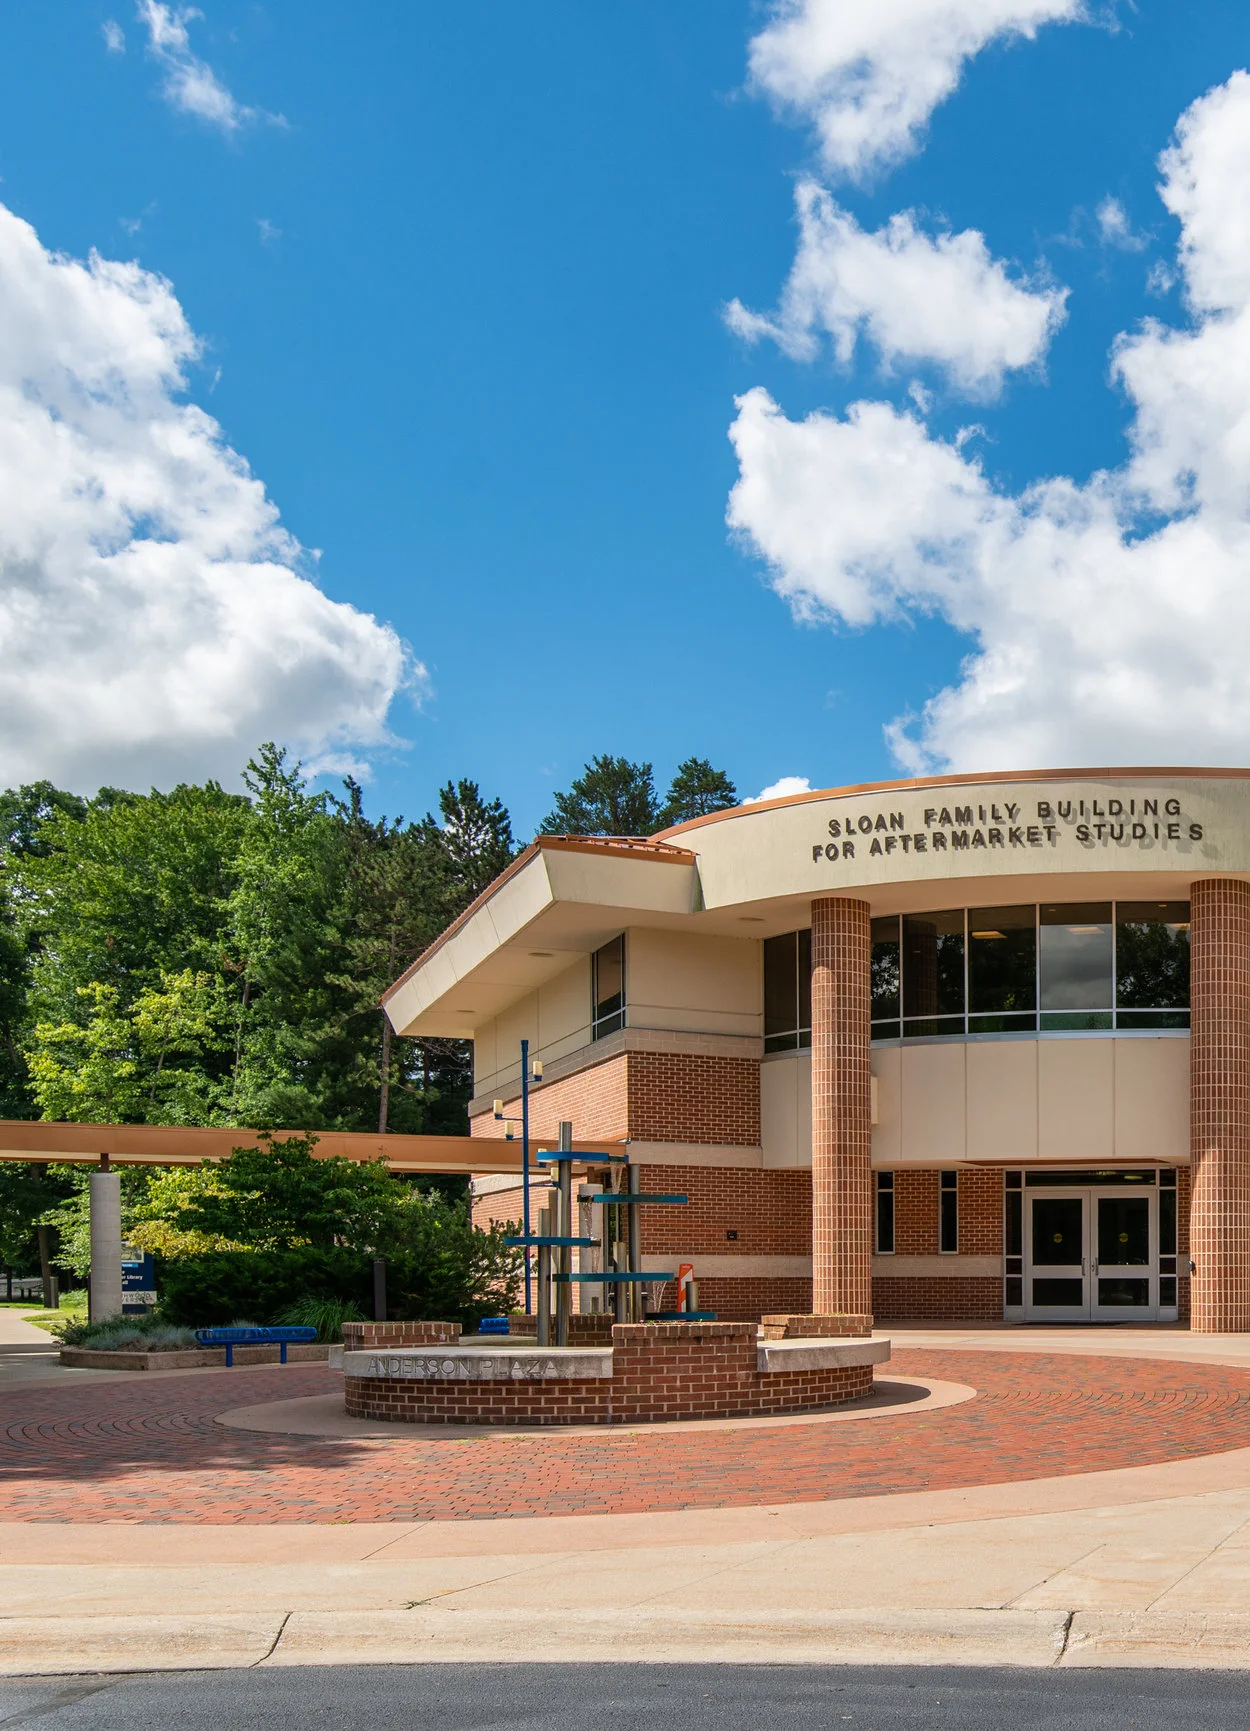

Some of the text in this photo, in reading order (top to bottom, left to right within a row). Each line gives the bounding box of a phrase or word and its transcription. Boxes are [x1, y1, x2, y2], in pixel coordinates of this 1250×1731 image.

[828, 798, 1181, 837] SLOAN FAMILY BUILDING
[812, 823, 1203, 862] FOR AFTERMARKET STUDIES
[367, 1357, 559, 1377] ANDERSON PLAZA
